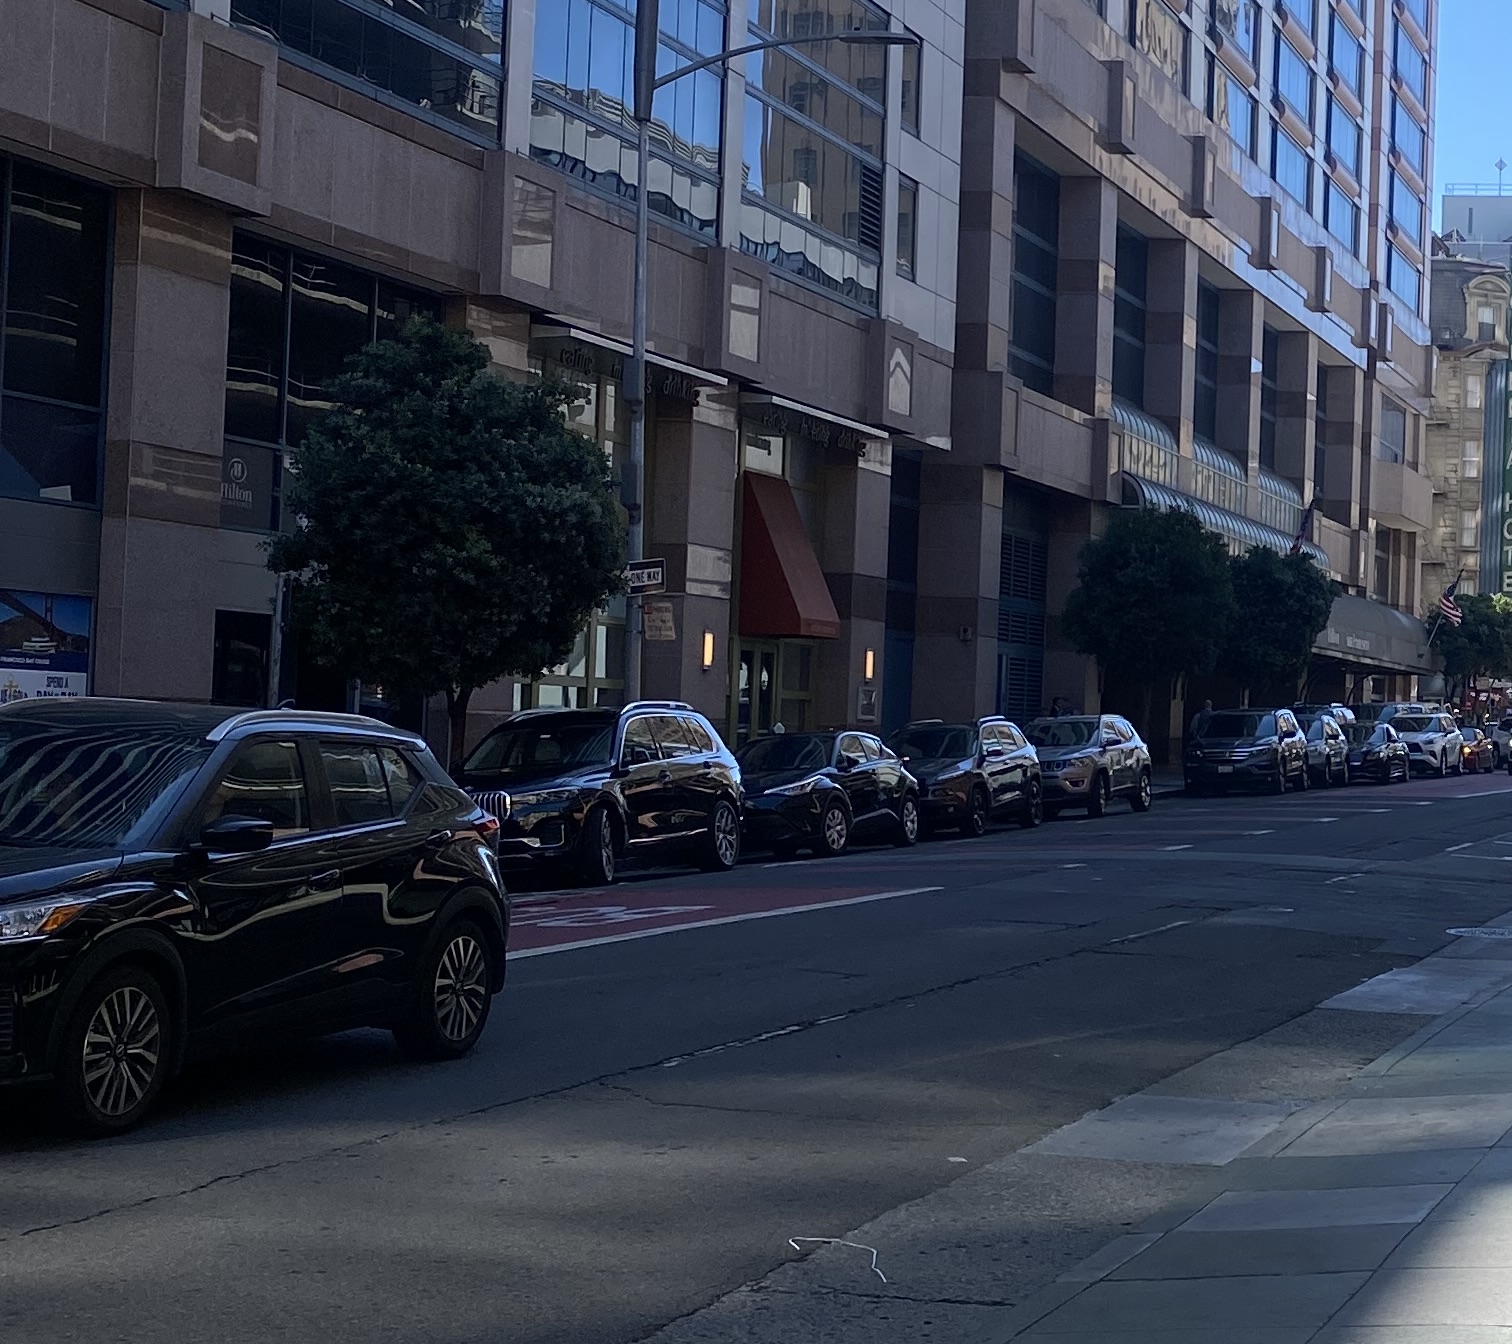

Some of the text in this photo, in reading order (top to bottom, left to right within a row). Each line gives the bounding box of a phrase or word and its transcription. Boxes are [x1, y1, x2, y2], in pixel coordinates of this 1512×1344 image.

[221, 482, 252, 502] Hilton
[630, 569, 661, 584] ONE WAY
